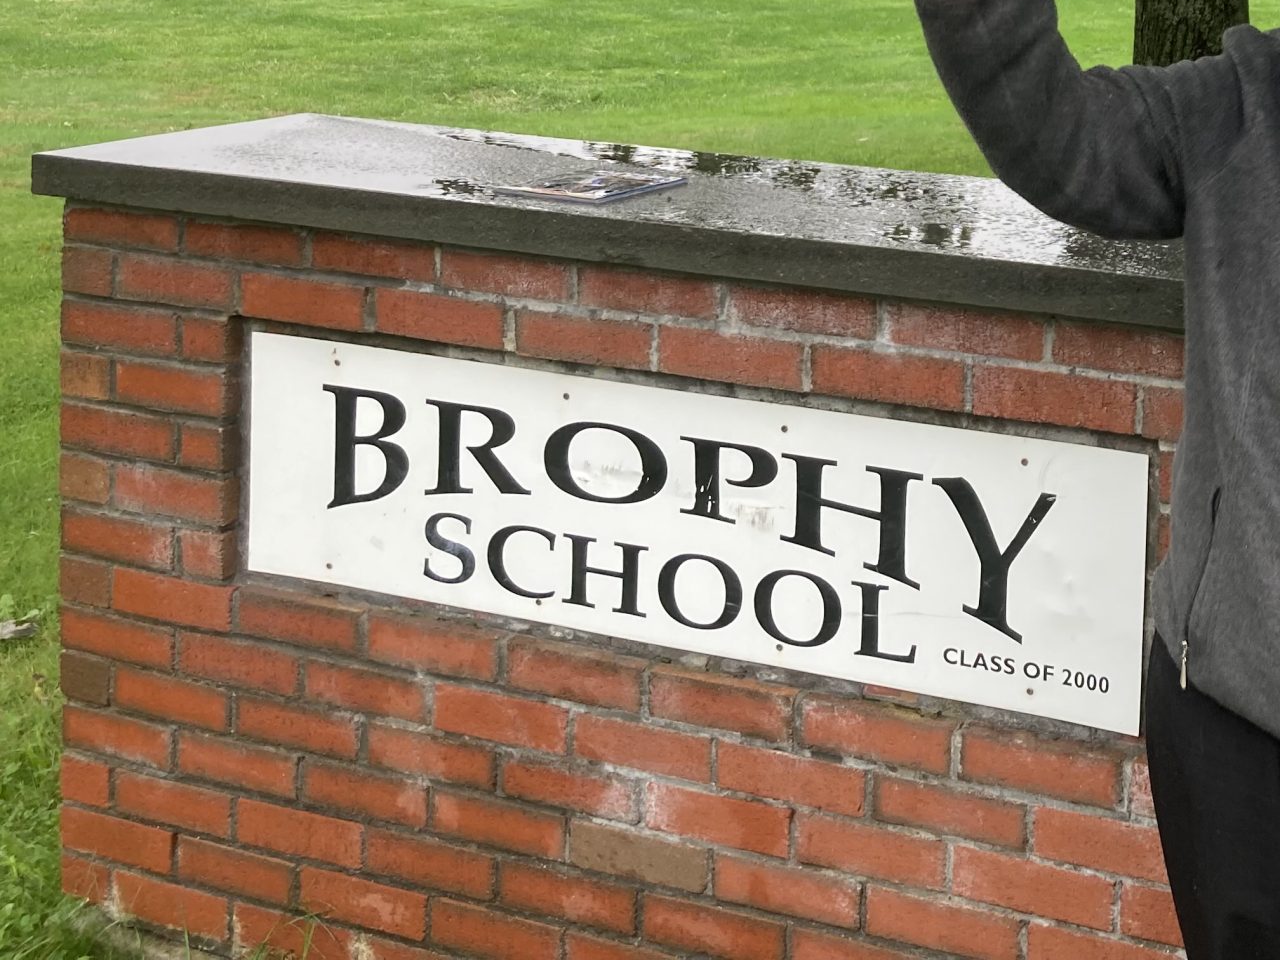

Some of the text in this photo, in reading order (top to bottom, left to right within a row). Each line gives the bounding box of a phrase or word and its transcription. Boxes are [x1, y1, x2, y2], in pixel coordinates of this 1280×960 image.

[322, 383, 1057, 645] BROPHY
[423, 512, 917, 664] SCHOOL
[943, 648, 1110, 694] CLASS OF 2000
